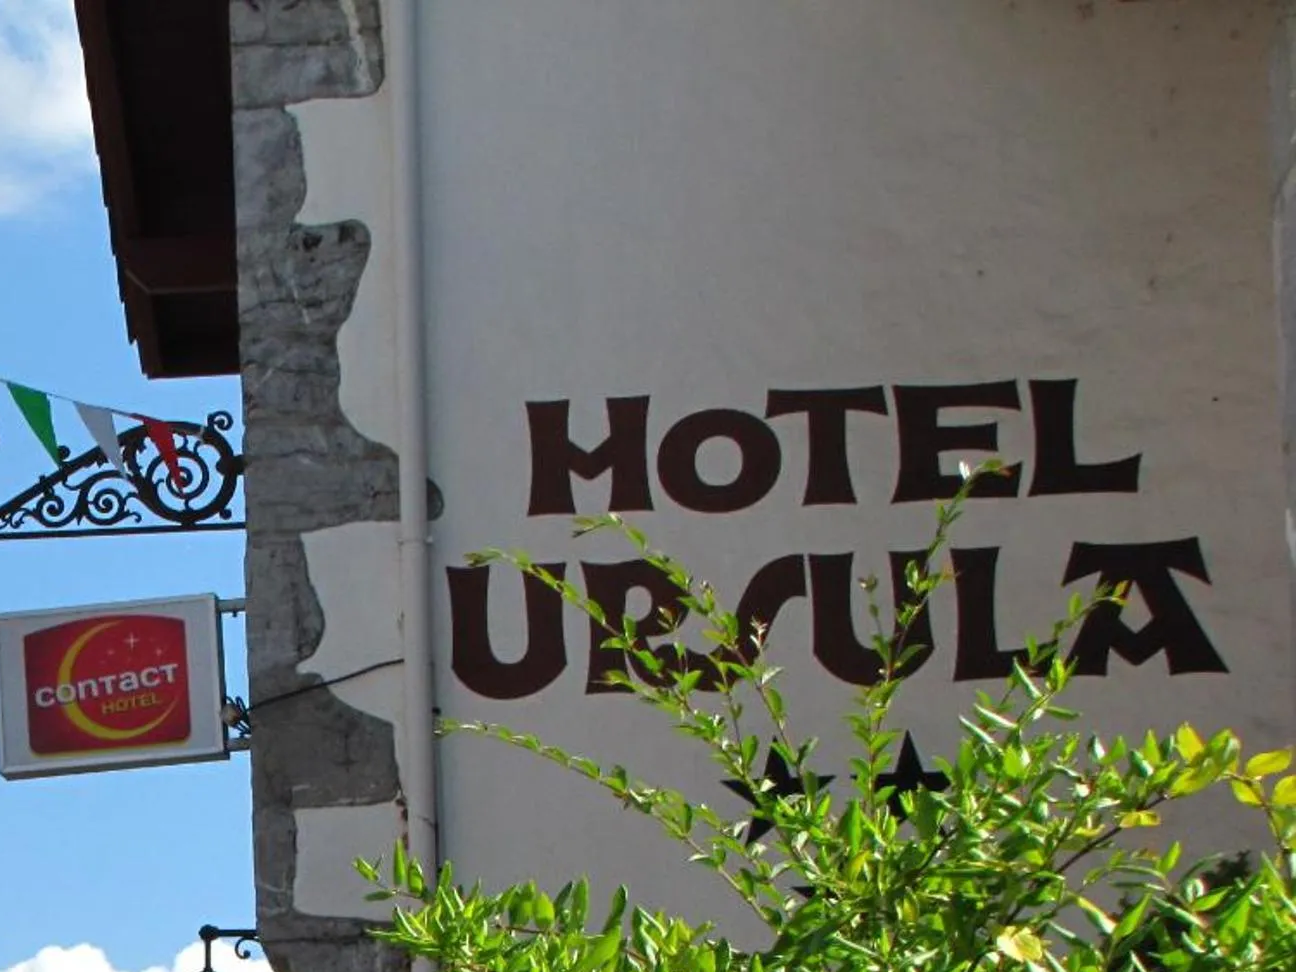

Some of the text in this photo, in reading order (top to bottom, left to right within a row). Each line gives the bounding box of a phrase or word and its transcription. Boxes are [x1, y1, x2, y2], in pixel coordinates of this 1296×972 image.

[525, 378, 1143, 516] HOTEL
[445, 536, 1230, 700] URSULA
[101, 692, 161, 715] HOTEL
